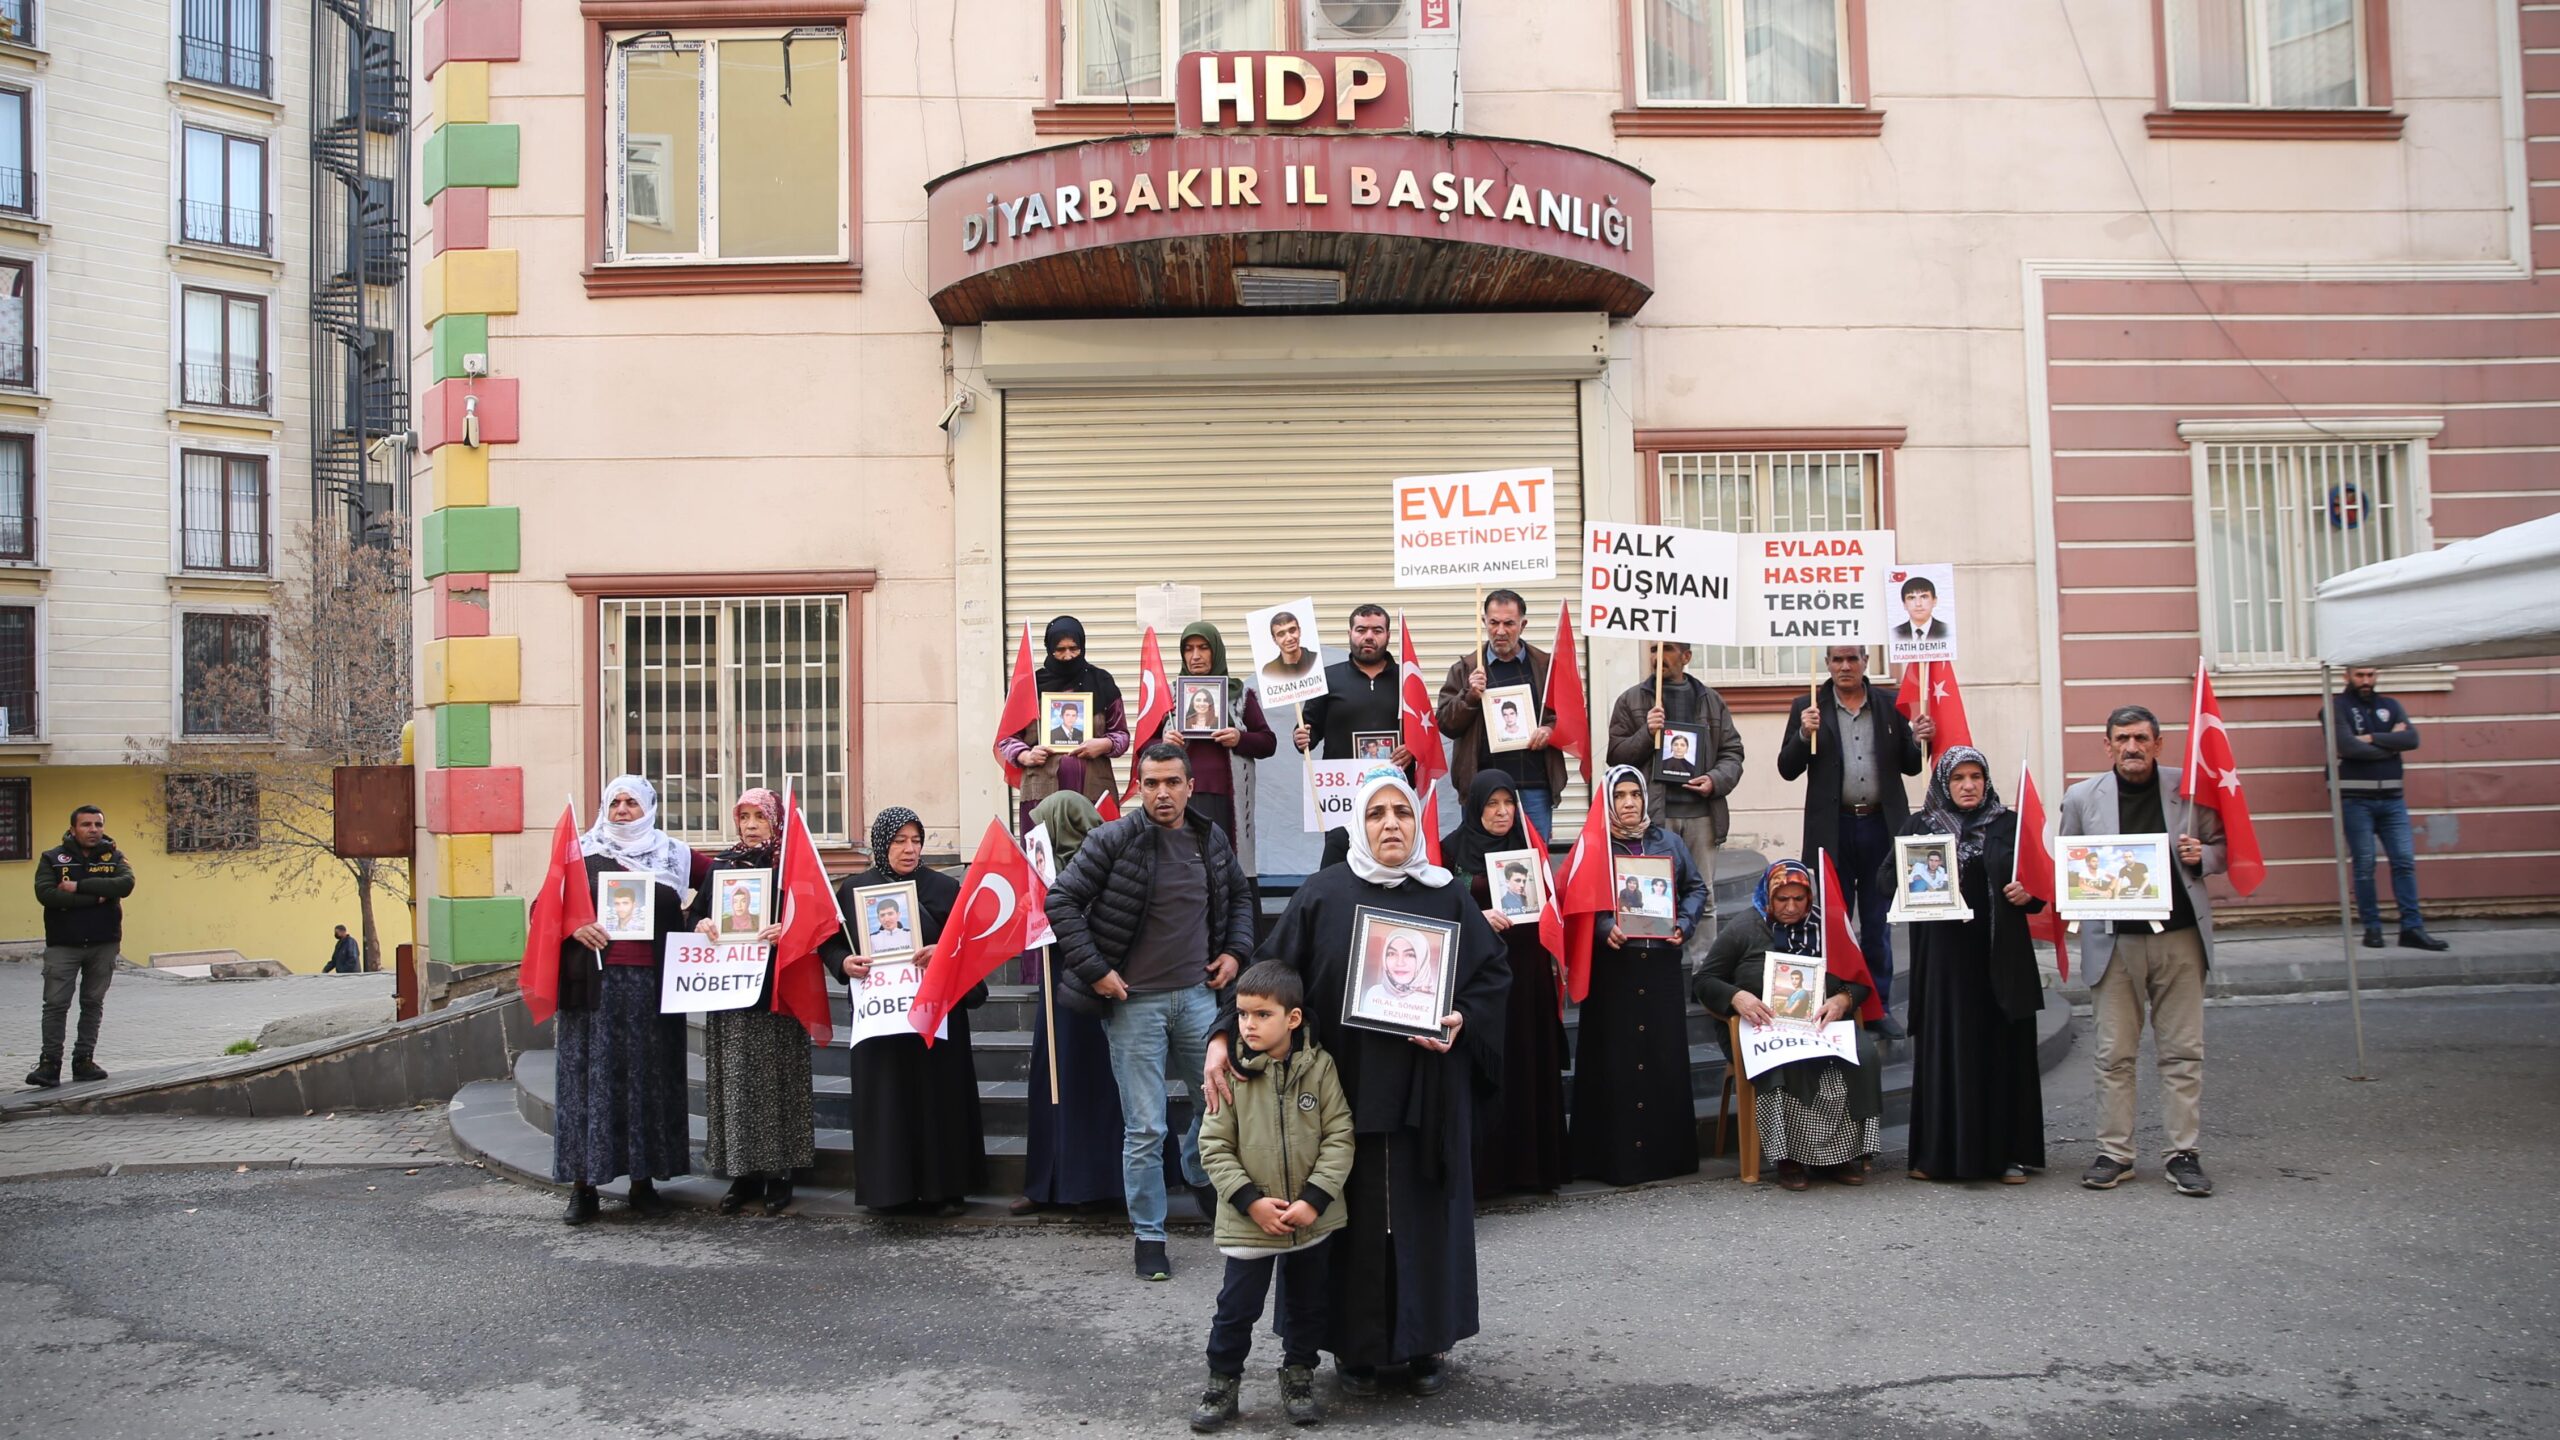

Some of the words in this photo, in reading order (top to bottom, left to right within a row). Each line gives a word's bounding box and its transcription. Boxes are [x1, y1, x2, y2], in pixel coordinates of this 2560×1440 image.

[1200, 55, 1387, 124] HDP
[963, 166, 1261, 252] DİYARBAKIR
[1350, 166, 1633, 251] BAŞKANLIĞI
[1400, 479, 1546, 521] EVLAT
[1401, 523, 1548, 548] NÖBETİNDEYİZ
[1592, 529, 1676, 558] HALK
[1765, 539, 1864, 557] EVLADA
[1401, 563, 1480, 576] DİYARBAKIR
[1482, 556, 1549, 572] ANNELERİ
[1764, 566, 1865, 584] HASRET
[1591, 563, 1729, 600] DÜŞMANI
[1764, 590, 1865, 610] TERÖRE
[1590, 605, 1677, 634] PARTİ
[1770, 620, 1859, 637] LANET!
[1895, 642, 1917, 652] FATİH
[1314, 772, 1351, 788] 338.
[678, 946, 721, 964] 338.
[726, 942, 768, 963] AİLE
[675, 971, 764, 993] NÖBETTE
